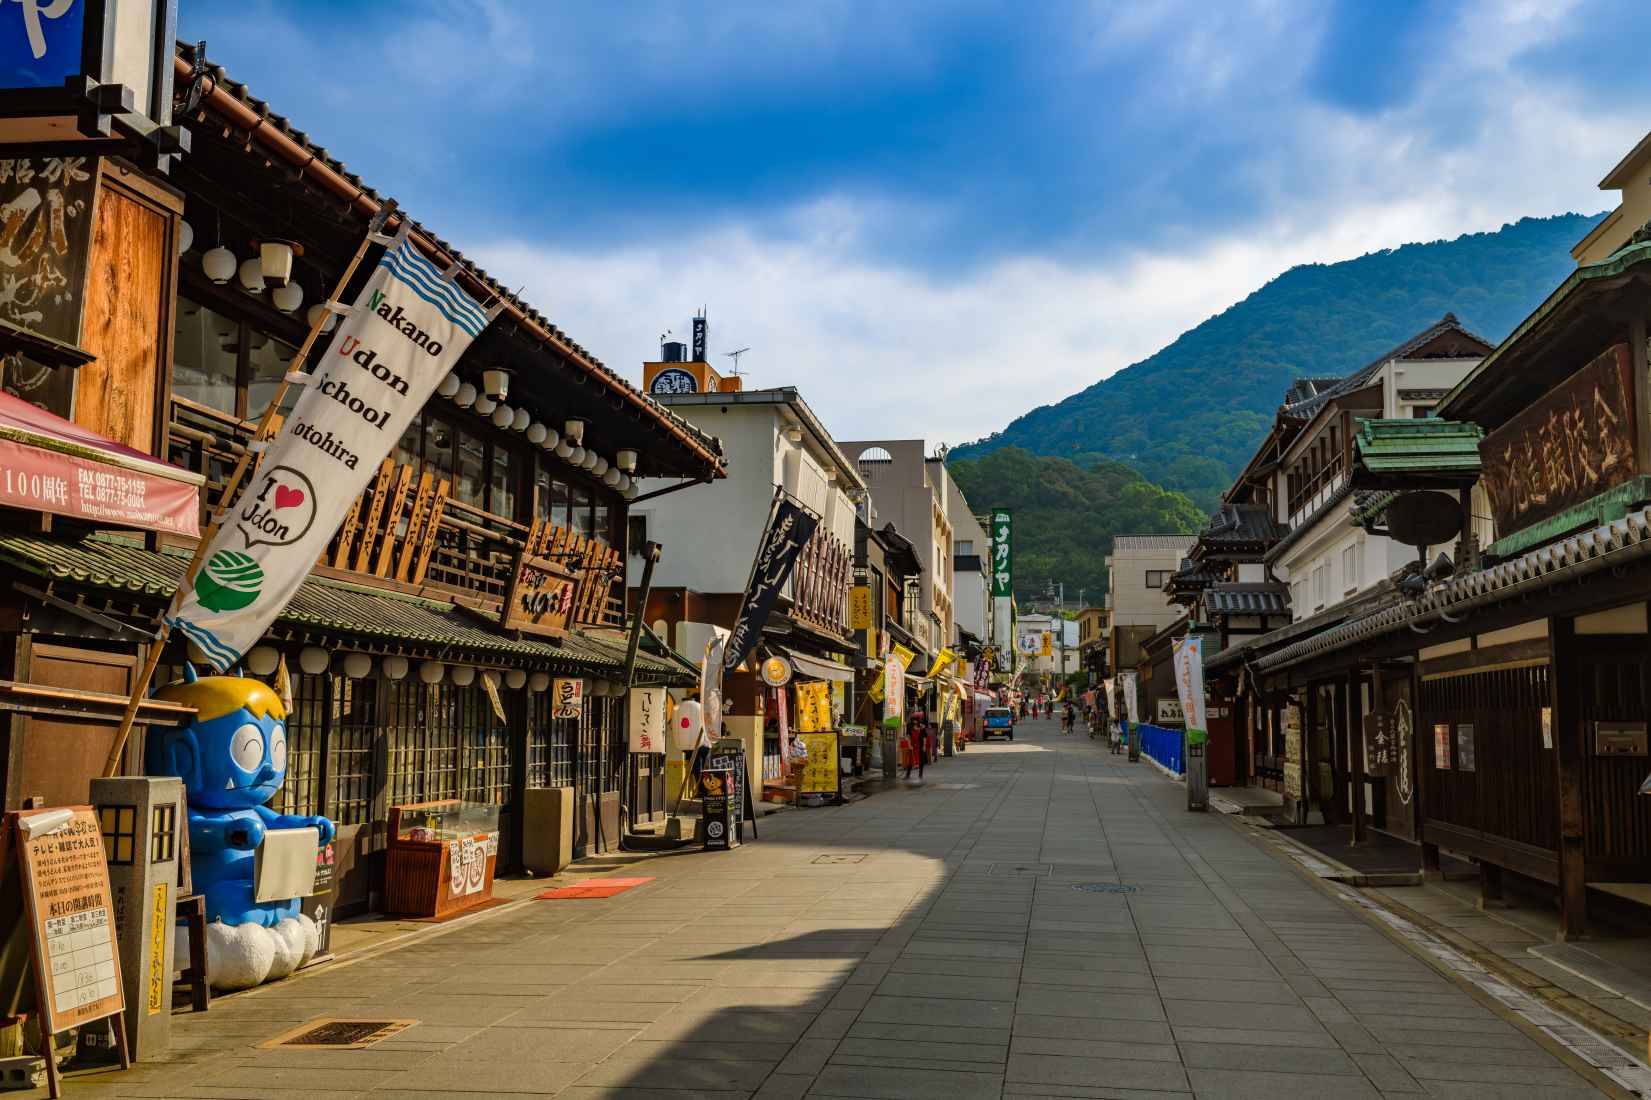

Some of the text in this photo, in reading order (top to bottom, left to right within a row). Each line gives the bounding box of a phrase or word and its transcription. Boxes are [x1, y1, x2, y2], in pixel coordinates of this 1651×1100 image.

[366, 288, 443, 357] Nakano
[339, 336, 410, 397] Udon
[290, 417, 360, 470] otohira
[78, 468, 95, 486] FAX
[995, 526, 1010, 592] ナカノヤ
[560, 681, 574, 717] うどん
